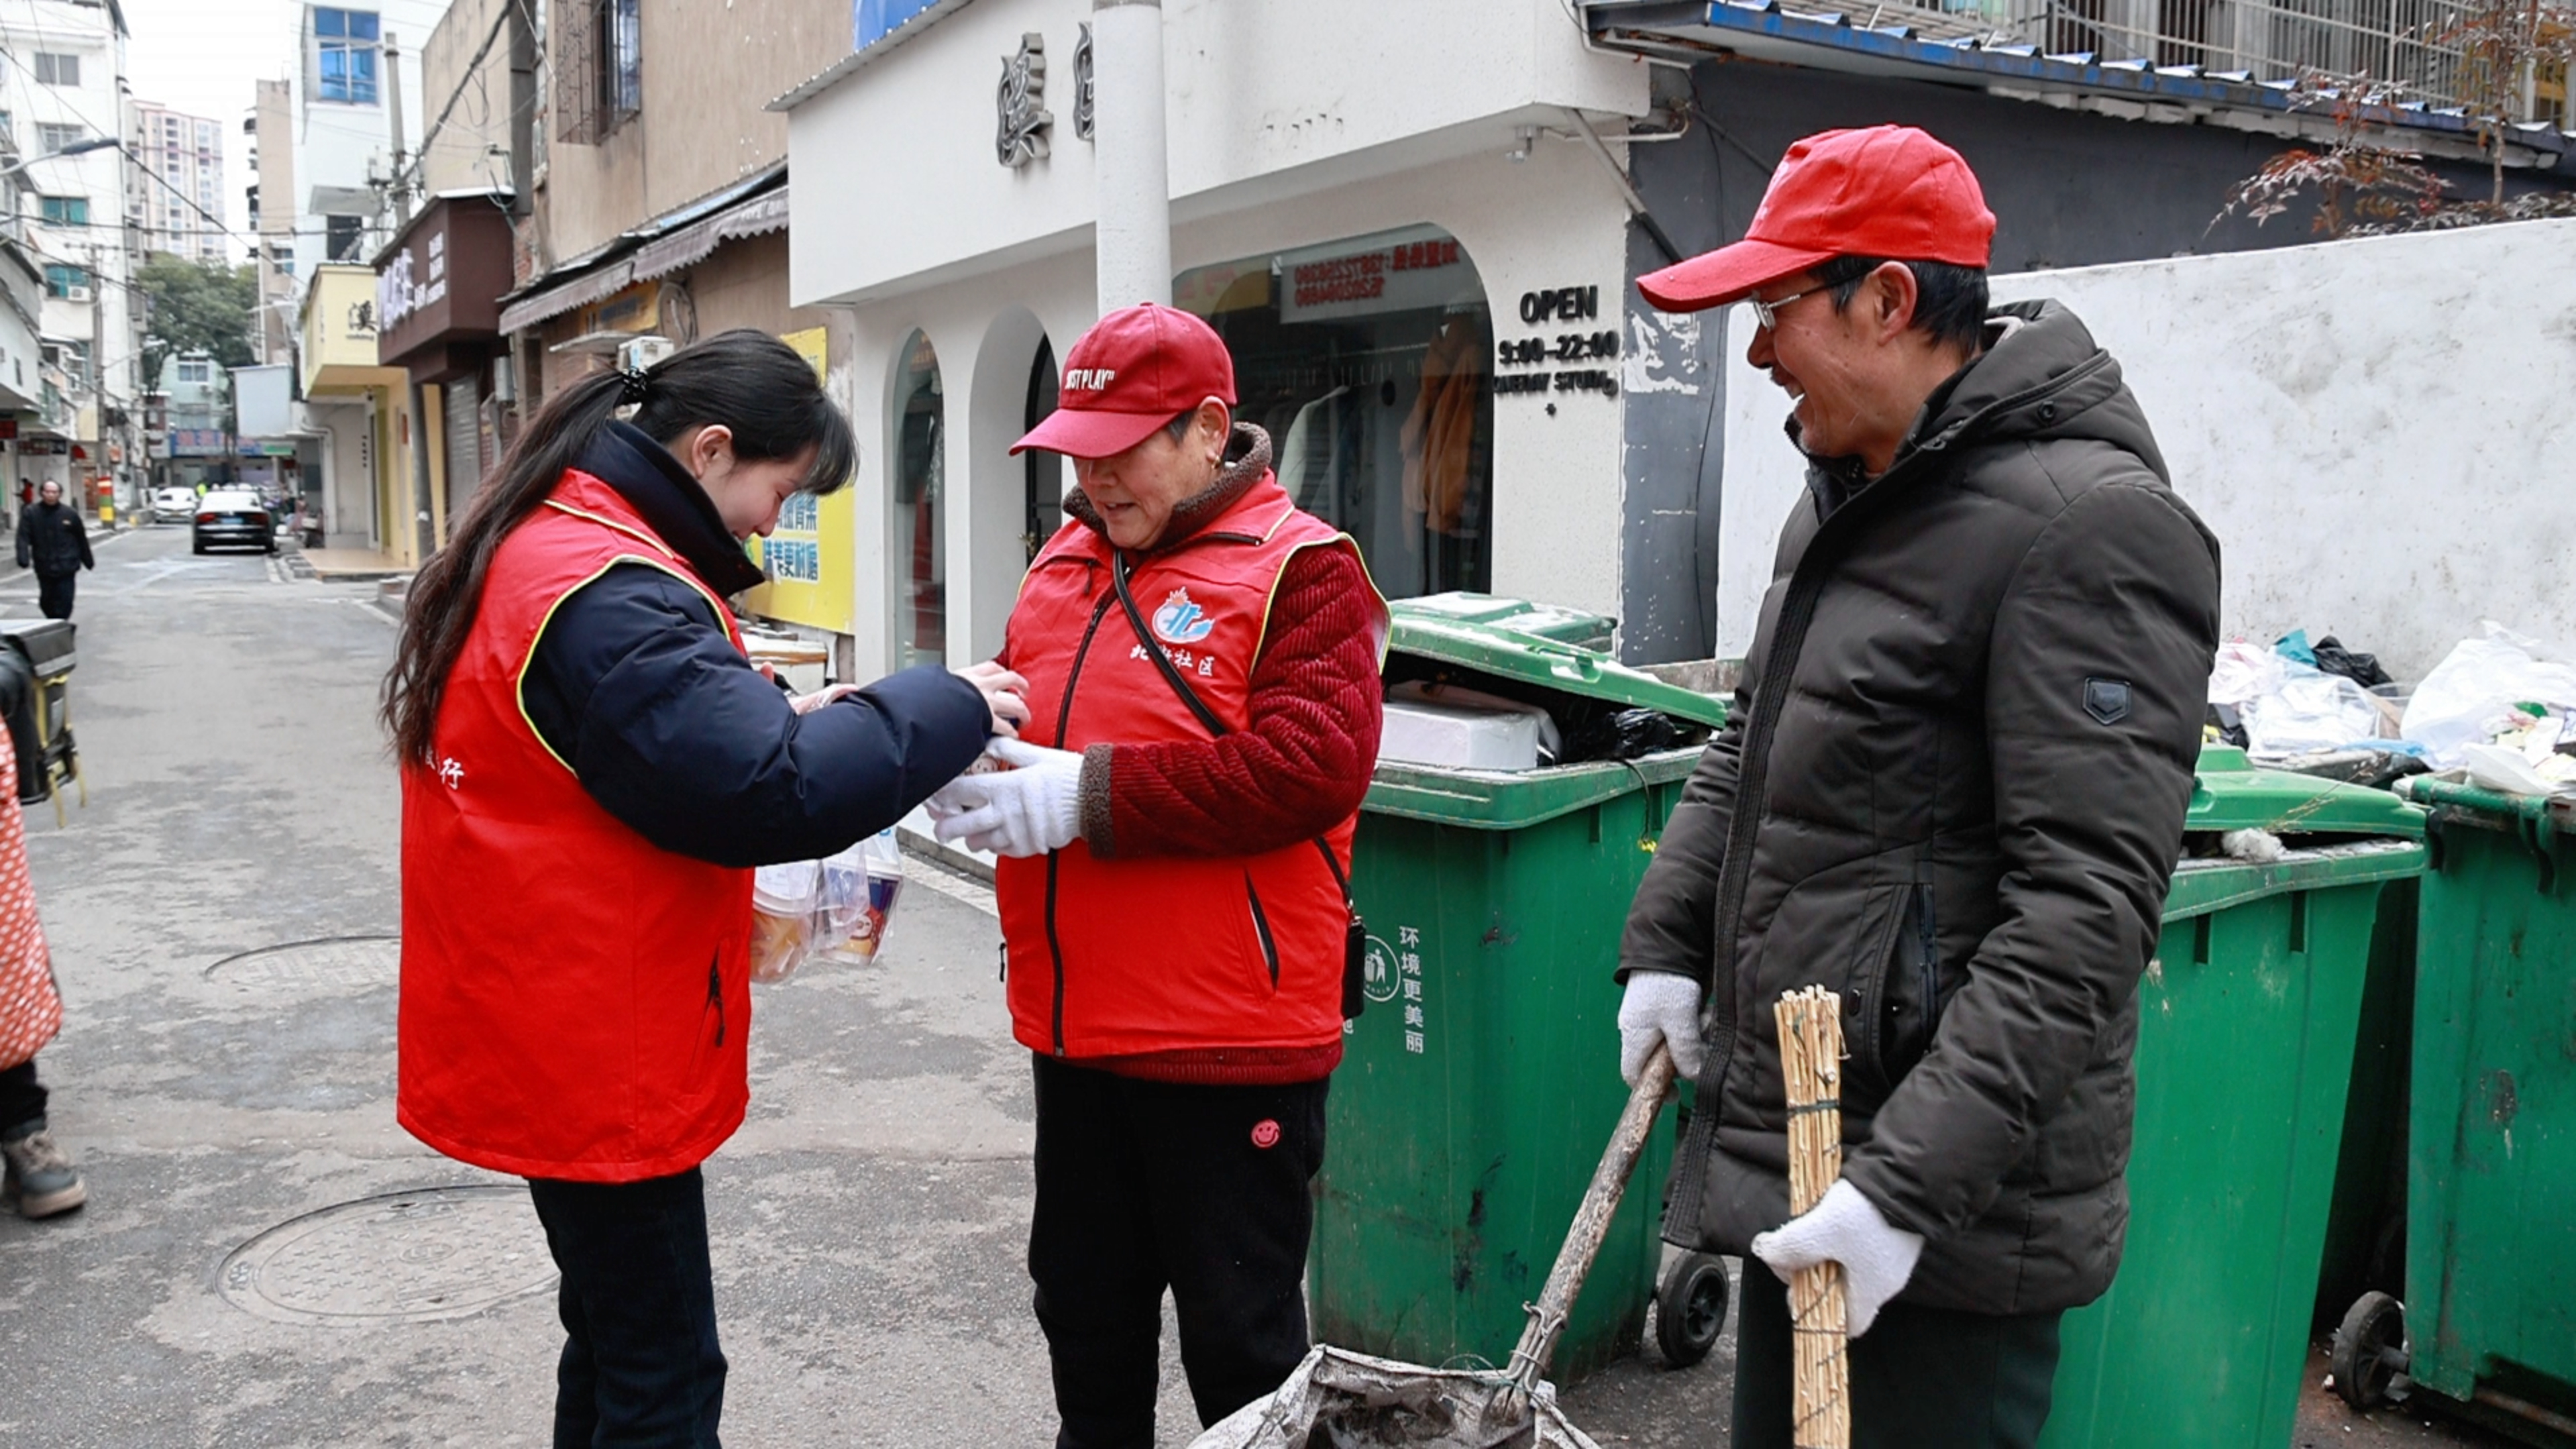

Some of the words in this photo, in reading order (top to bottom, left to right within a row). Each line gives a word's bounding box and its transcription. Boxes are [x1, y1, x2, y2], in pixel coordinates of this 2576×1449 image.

[1519, 285, 1598, 323] OPEN
[1399, 925, 1424, 1054] 环境更美丽
